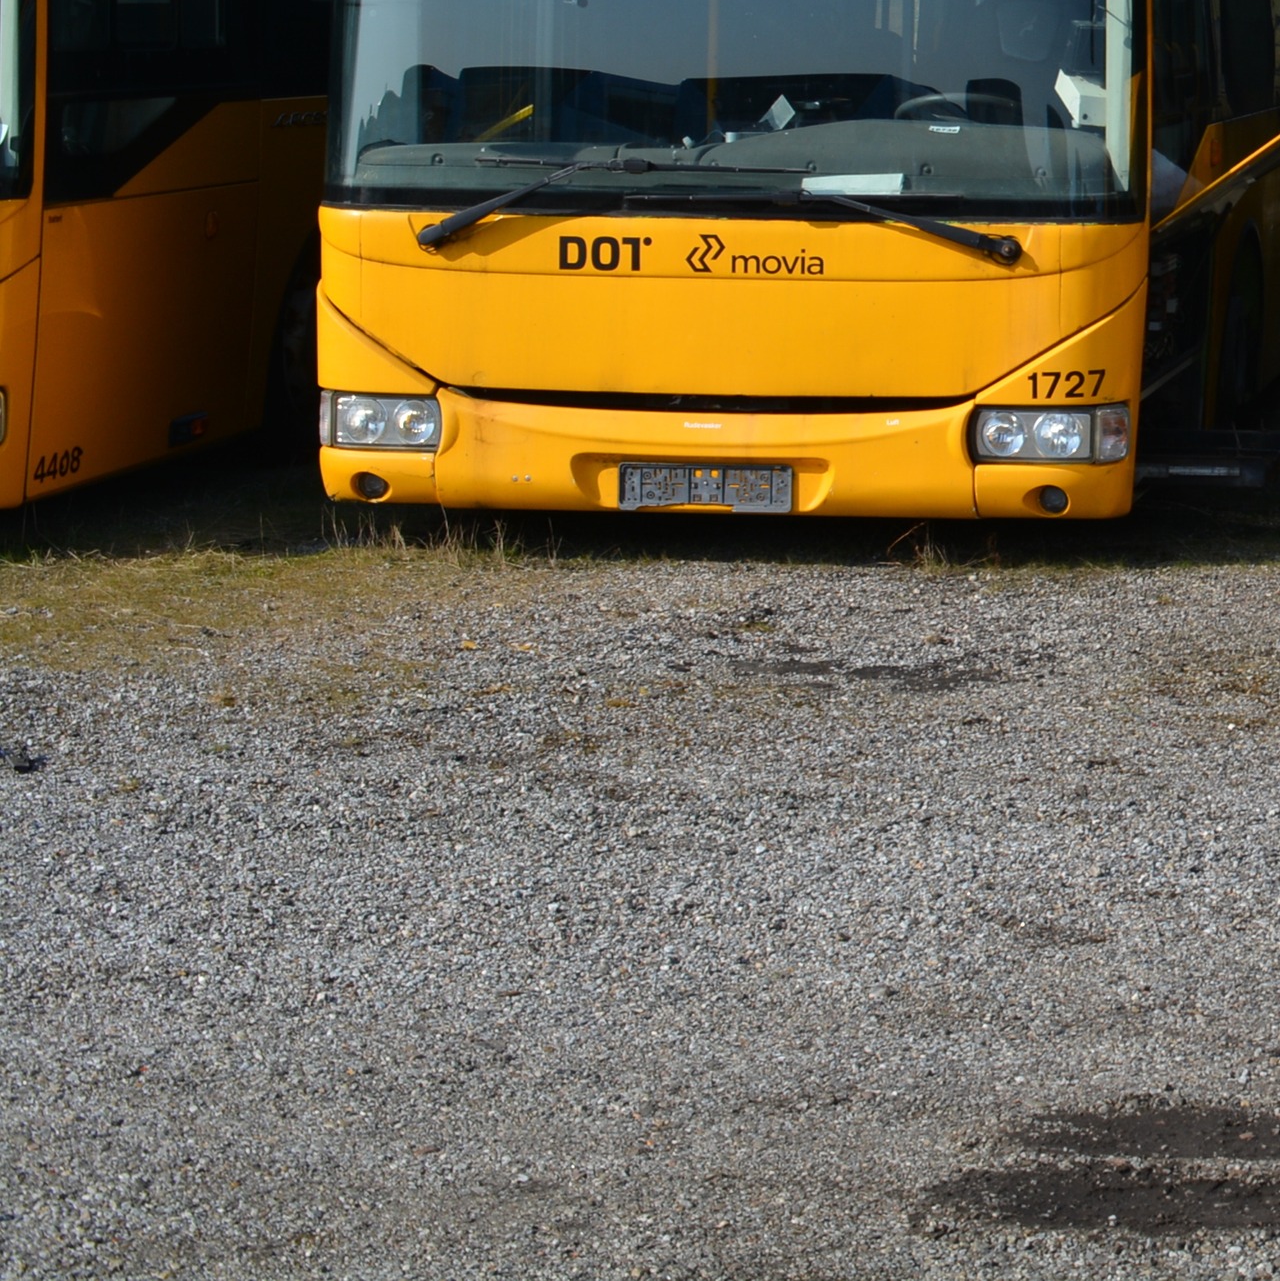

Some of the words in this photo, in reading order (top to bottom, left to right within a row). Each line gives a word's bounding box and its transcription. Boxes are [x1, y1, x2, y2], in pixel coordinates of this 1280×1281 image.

[559, 236, 652, 271] DOT
[731, 250, 824, 275] movia
[1027, 369, 1106, 400] 1727
[34, 445, 83, 484] 4408
